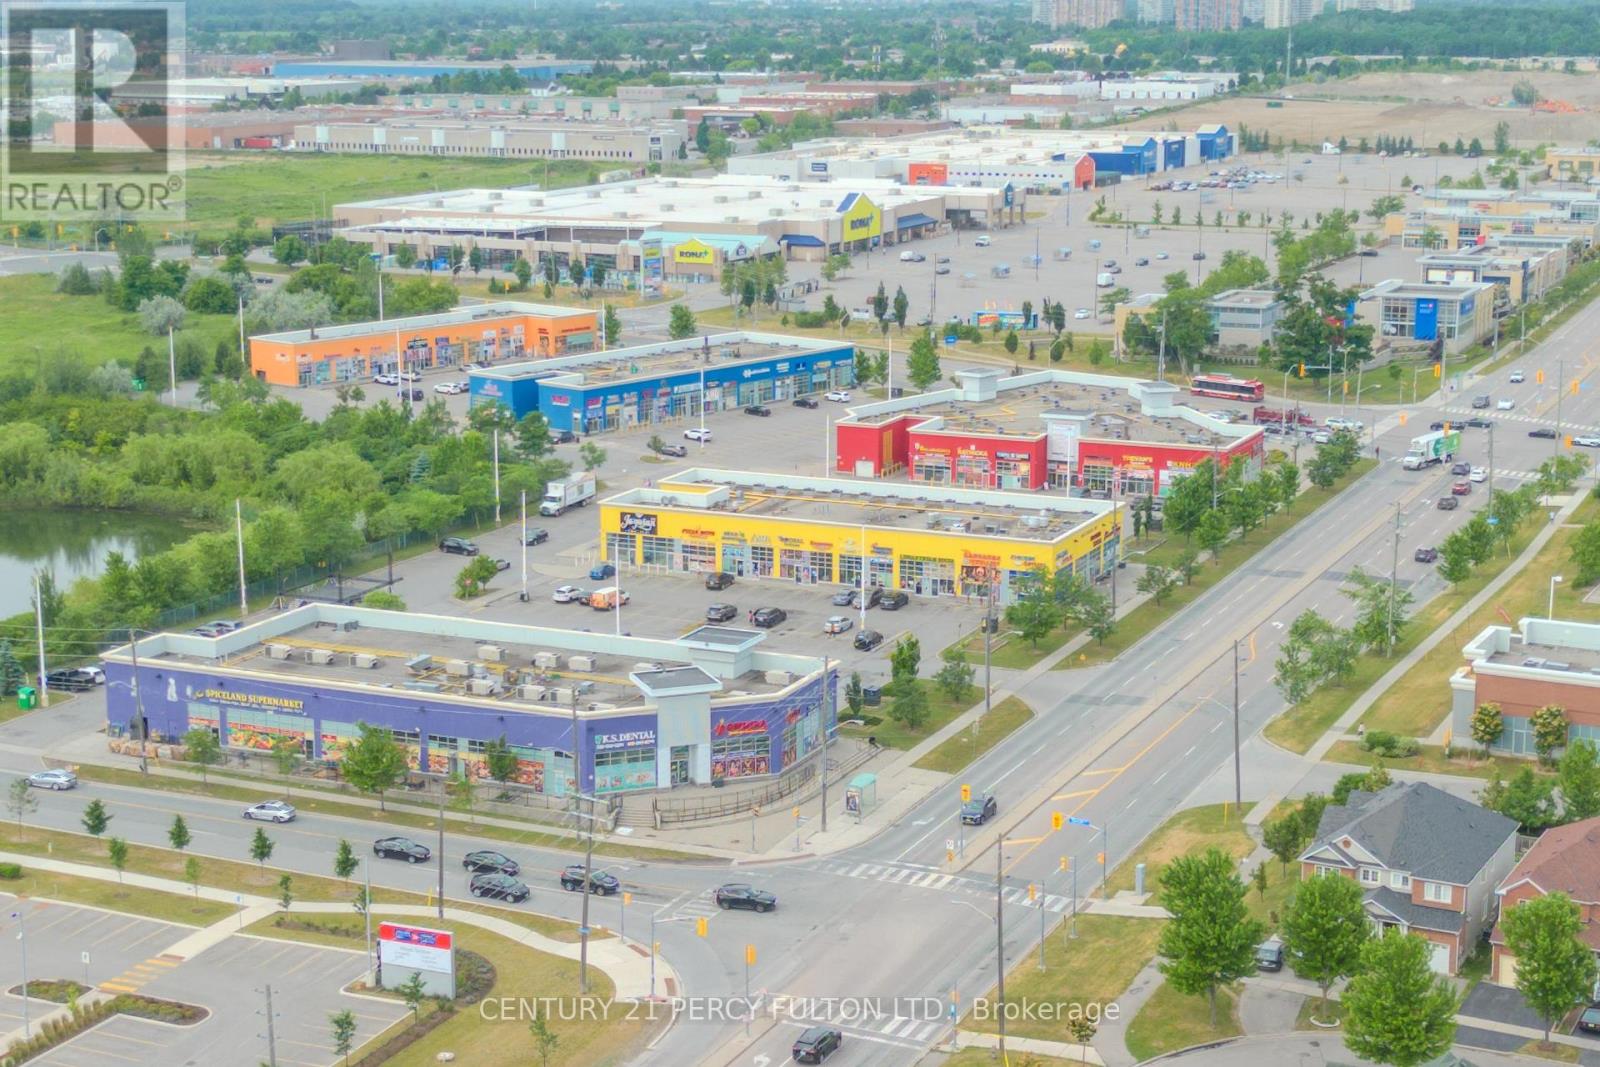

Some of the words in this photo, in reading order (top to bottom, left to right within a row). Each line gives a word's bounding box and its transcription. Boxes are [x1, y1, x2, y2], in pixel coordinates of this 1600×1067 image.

[206, 688, 247, 702] SPICELAND
[248, 694, 304, 709] SUPERMARKET
[619, 730, 655, 742] DENTAL
